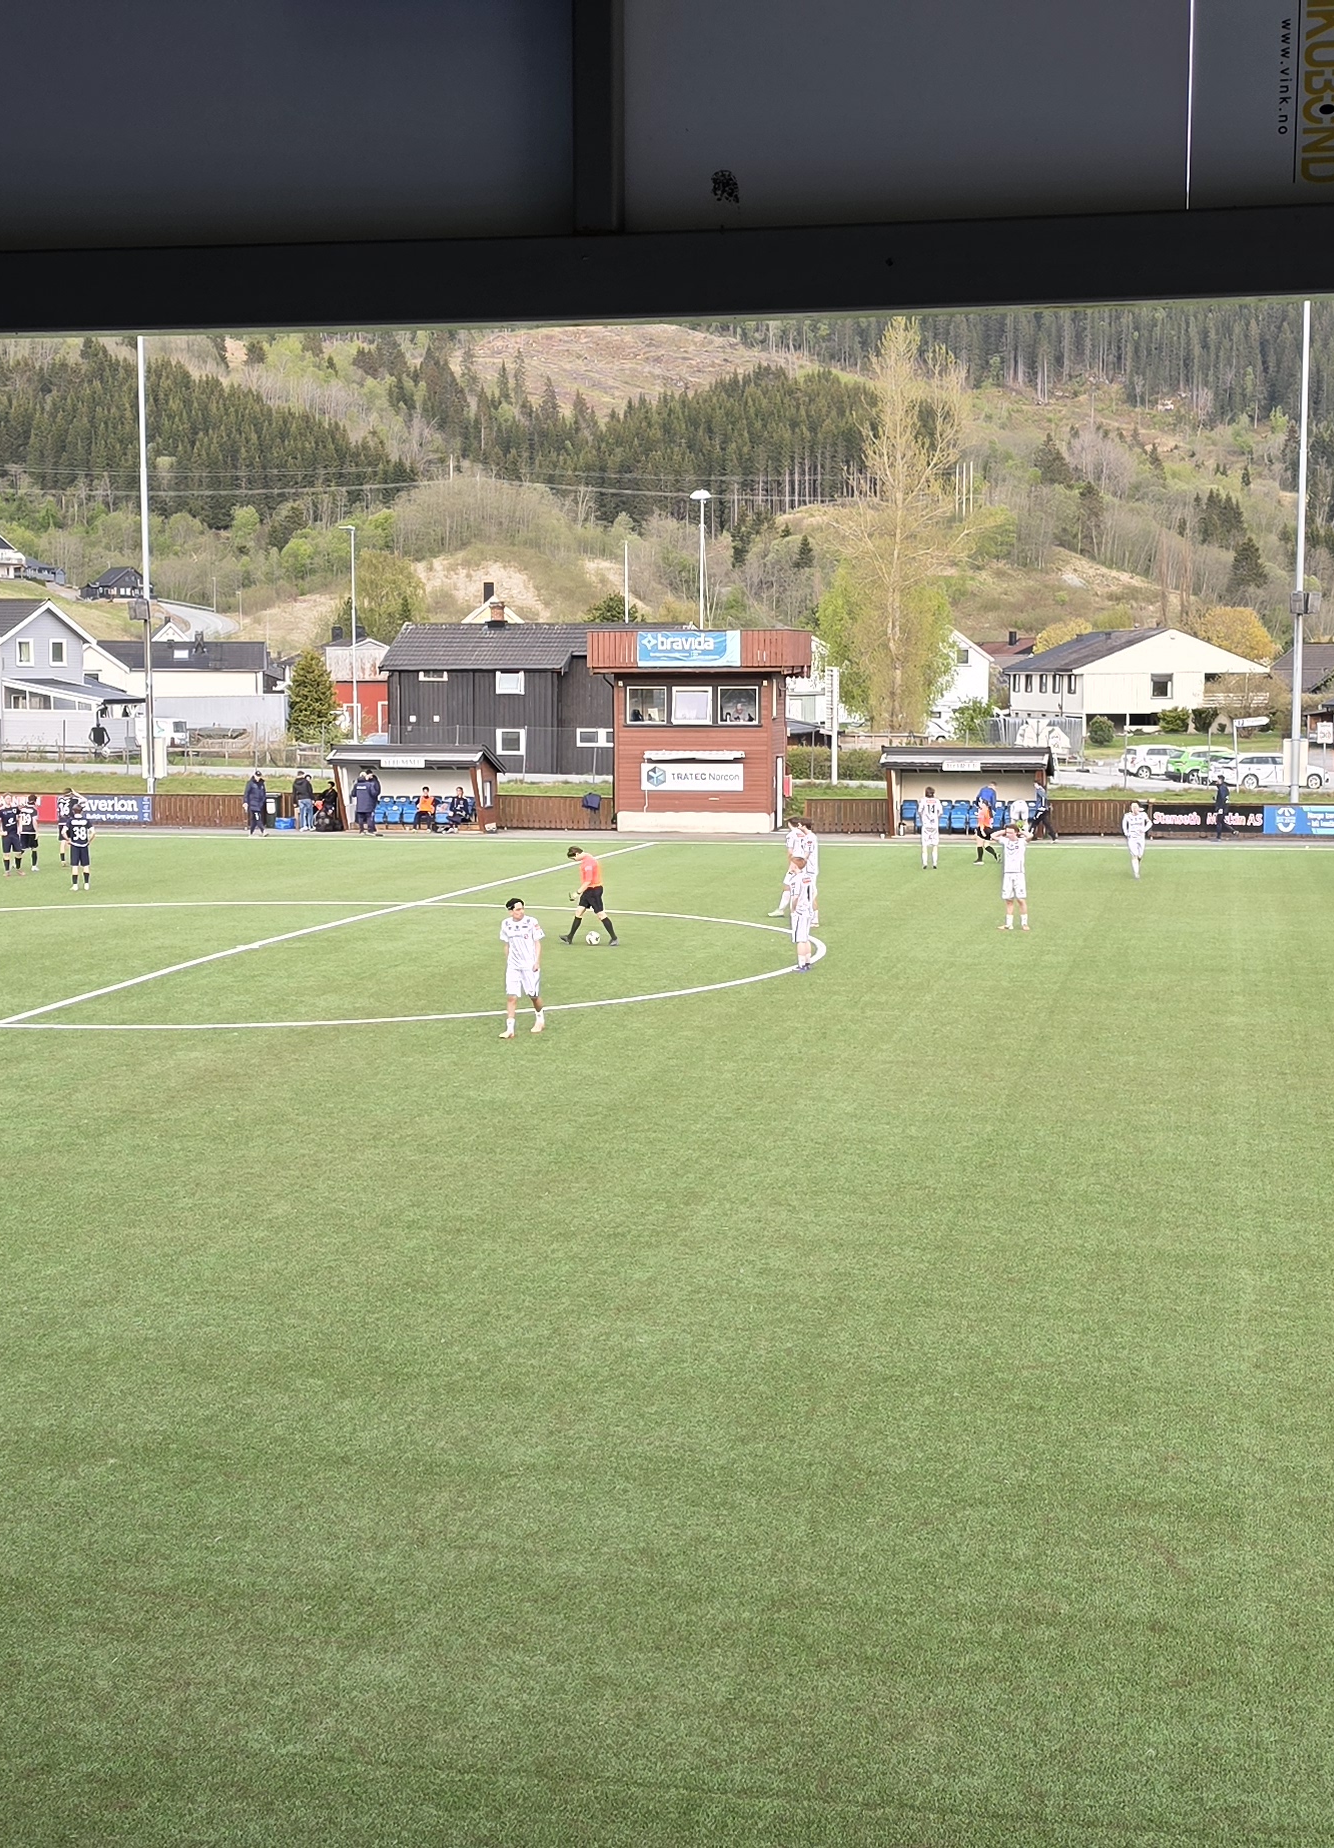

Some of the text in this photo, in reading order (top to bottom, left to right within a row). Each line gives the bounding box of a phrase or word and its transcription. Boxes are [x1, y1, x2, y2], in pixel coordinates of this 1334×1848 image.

[1277, 17, 1294, 135] www.vink.no
[657, 633, 714, 650] bravida
[671, 772, 740, 781] TRATEC Norcon
[75, 797, 139, 812] averion
[1206, 812, 1246, 826] Mskin
[1247, 813, 1264, 827] AS
[72, 826, 87, 840] 38
